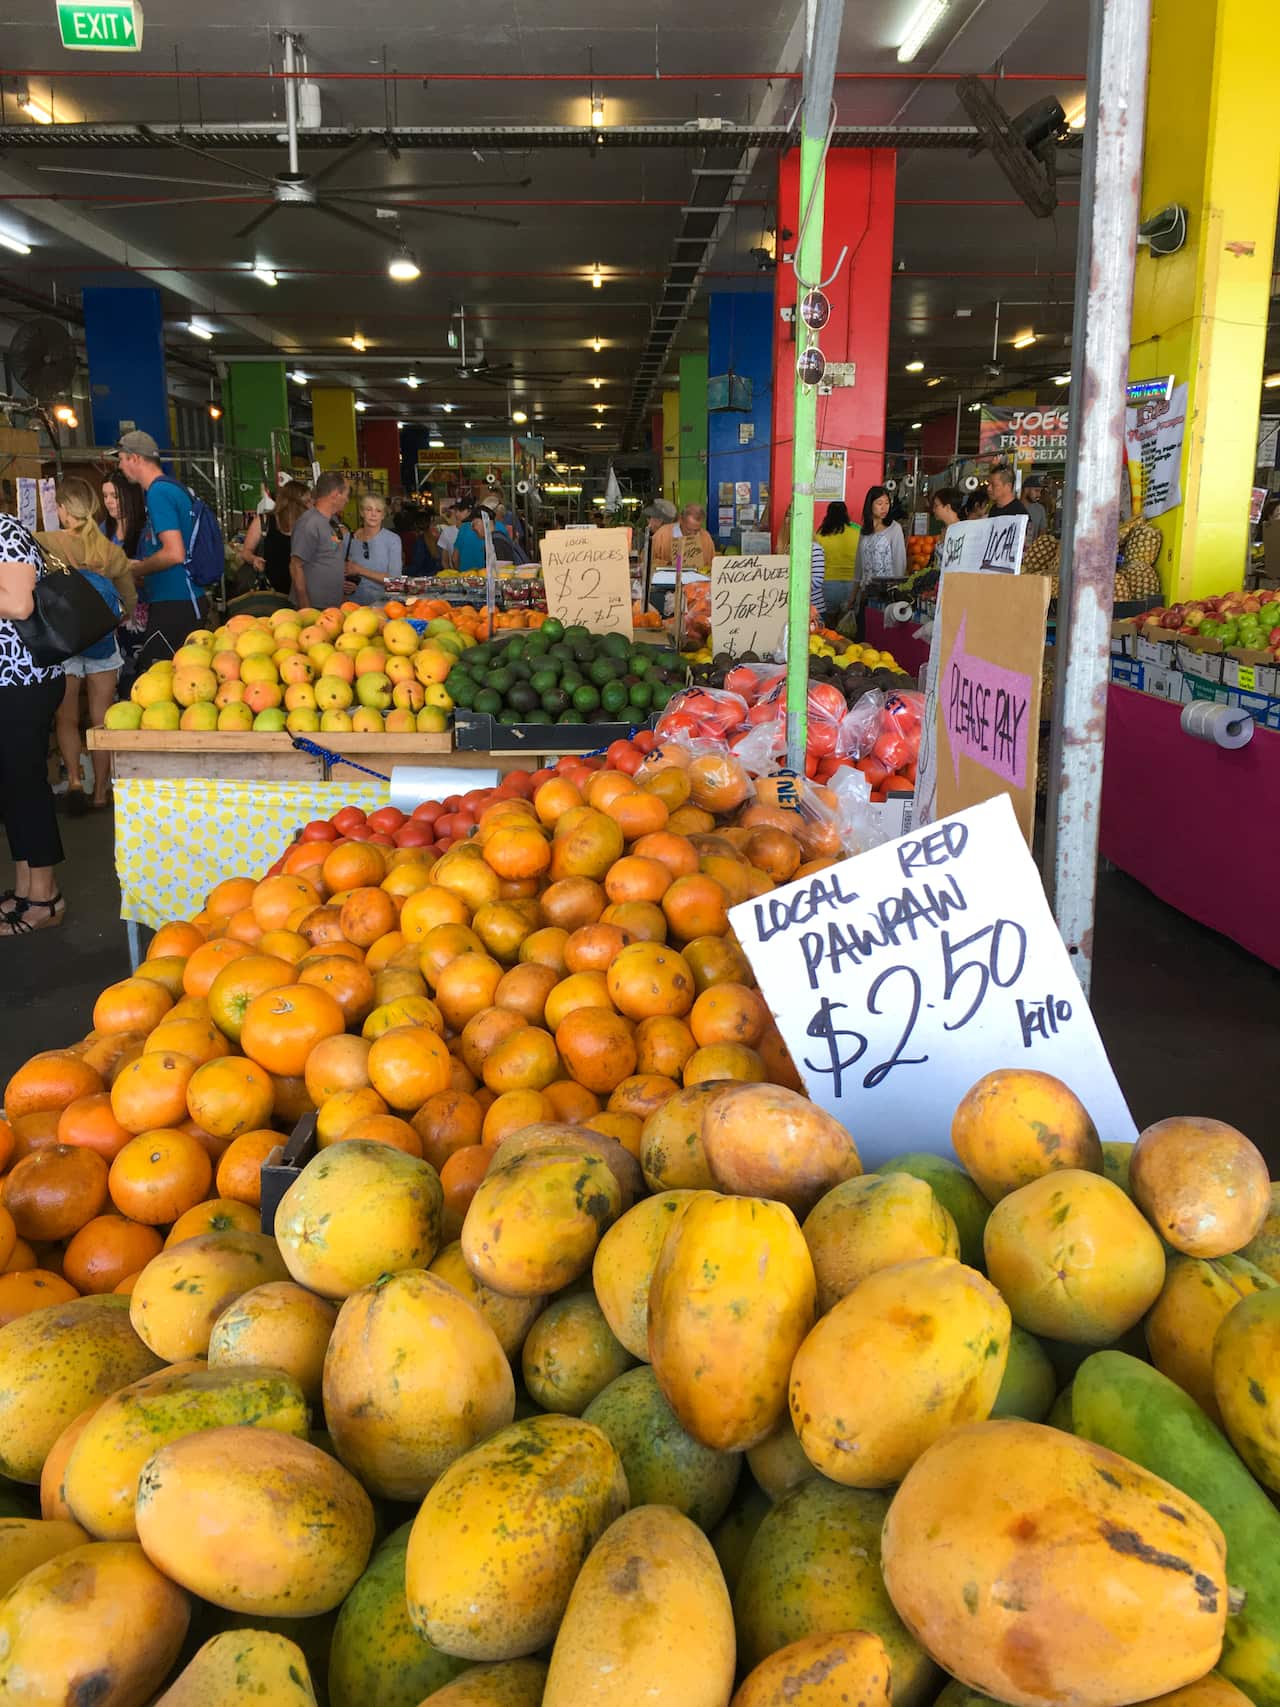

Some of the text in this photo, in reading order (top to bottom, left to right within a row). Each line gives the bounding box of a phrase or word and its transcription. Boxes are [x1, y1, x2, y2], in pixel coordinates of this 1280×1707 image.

[73, 12, 119, 39] EXIT
[1000, 434, 1068, 448] FRESH FR
[1016, 449, 1067, 461] VEGETA
[722, 556, 762, 569] LOCAL
[712, 590, 732, 626] 3
[948, 663, 991, 752] PLEASE
[992, 687, 1027, 776] PAY
[754, 822, 968, 942] LOCAL RED
[799, 873, 968, 990] PAWPAW
[804, 918, 1028, 1098] $2.50
